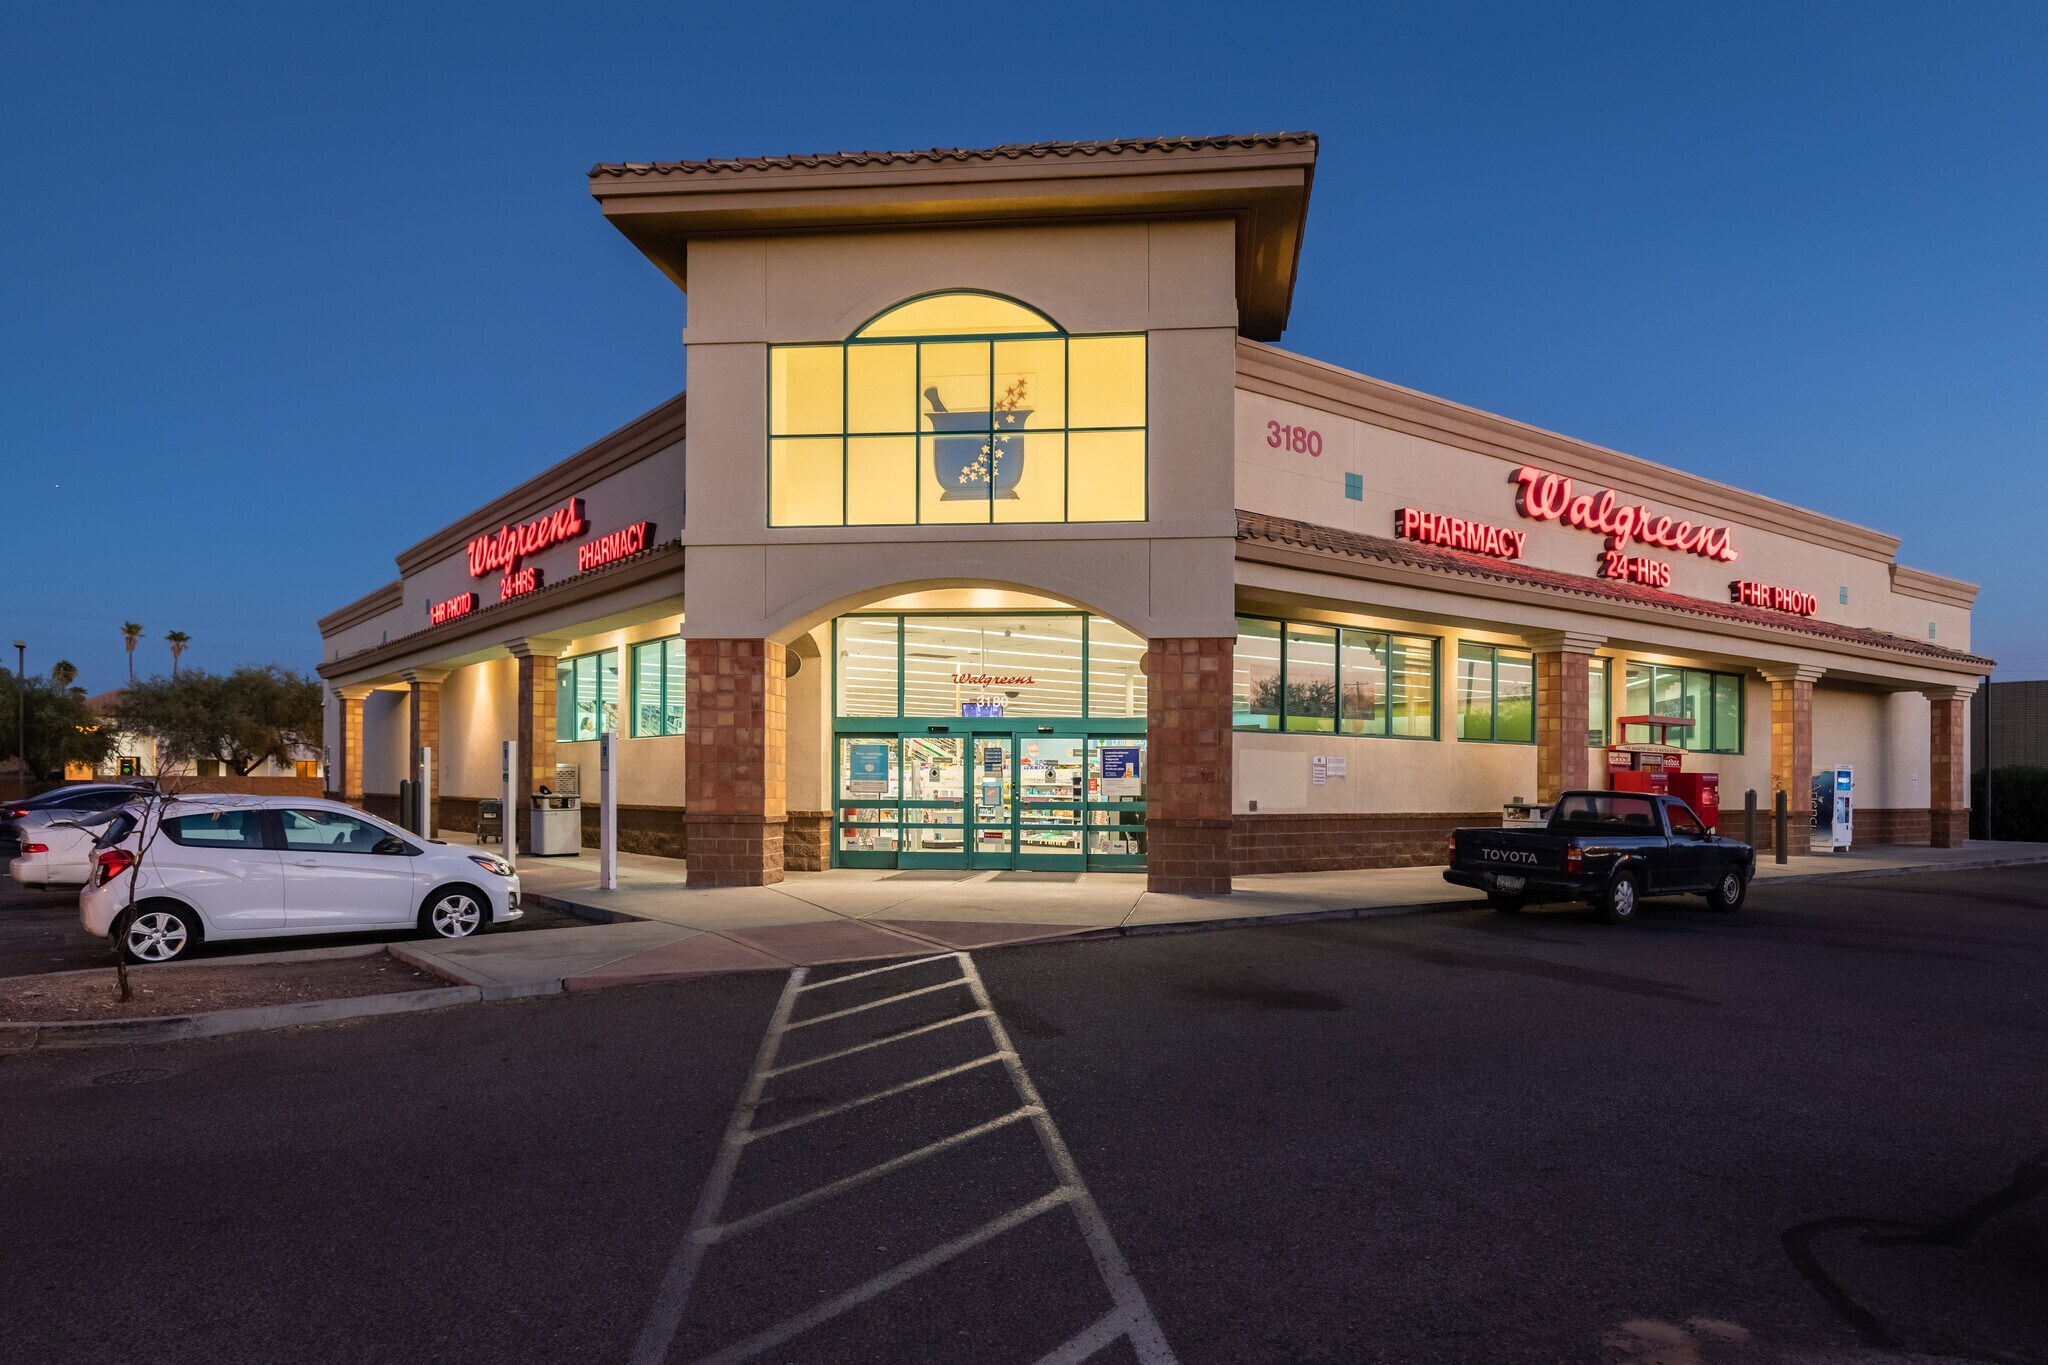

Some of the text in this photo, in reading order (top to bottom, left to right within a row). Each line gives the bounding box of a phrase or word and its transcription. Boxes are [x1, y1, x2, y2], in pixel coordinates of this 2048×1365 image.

[1266, 420, 1323, 458] 3180
[1517, 465, 1739, 562] Walgreens
[467, 497, 583, 576] Walgreens
[578, 521, 647, 572] PHARMACY
[1403, 507, 1527, 559] PHARMACY
[500, 567, 537, 601] 24-HRS
[1606, 550, 1672, 588] 24-HRS
[430, 592, 472, 626] 1-HR PHOTO
[1737, 580, 1818, 617] 1-HR PHOTO
[951, 673, 1036, 689] Walgreens
[976, 696, 1009, 708] 3180
[1663, 757, 1681, 767] redbox
[1482, 849, 1538, 864] TOYOTA
